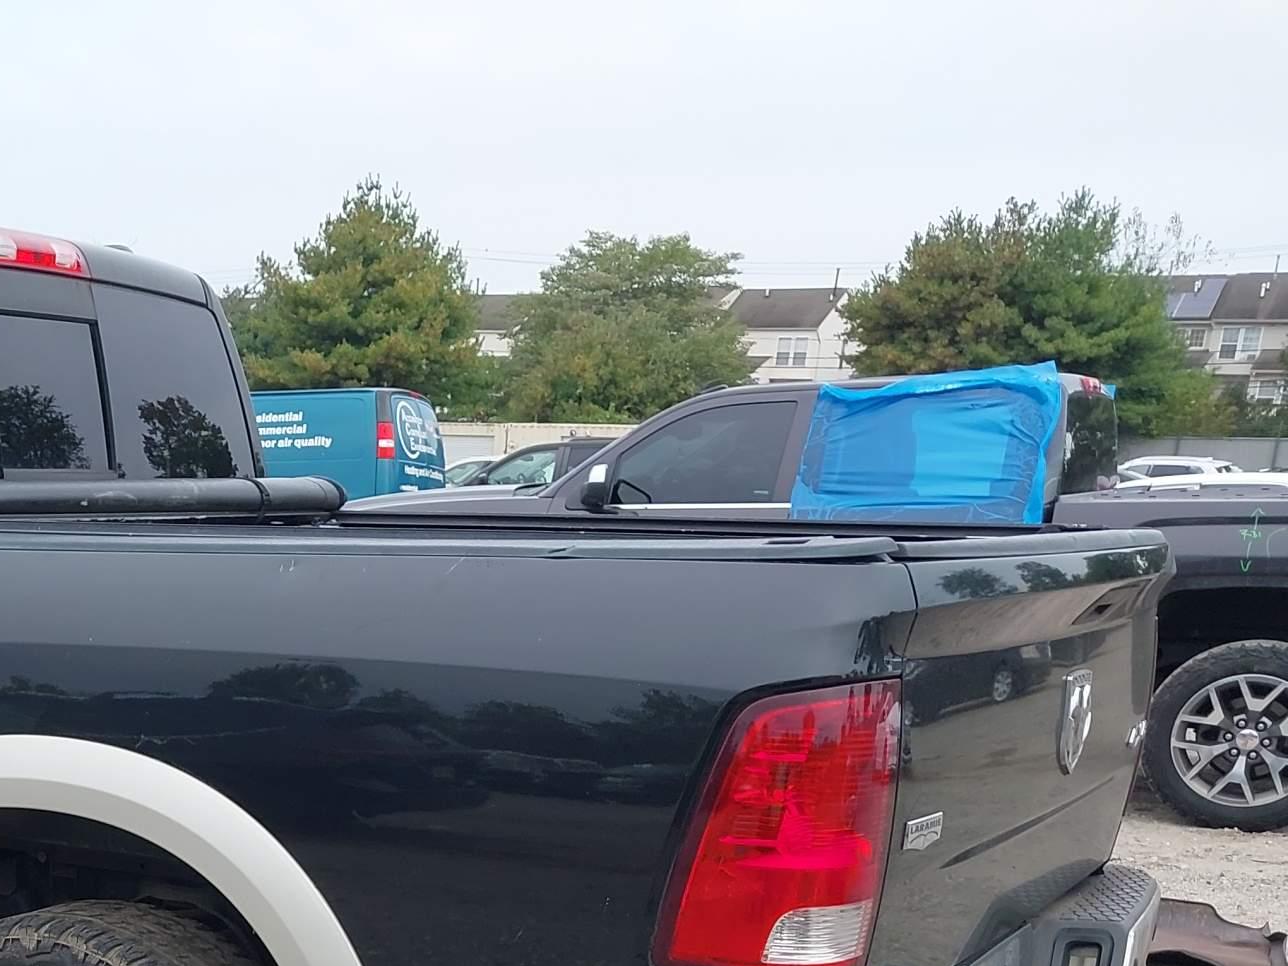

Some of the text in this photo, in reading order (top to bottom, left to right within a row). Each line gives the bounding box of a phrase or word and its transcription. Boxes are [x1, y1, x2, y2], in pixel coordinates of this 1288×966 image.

[277, 437, 293, 447] air
[293, 435, 332, 448] quality
[910, 816, 942, 835] LARAMIE
